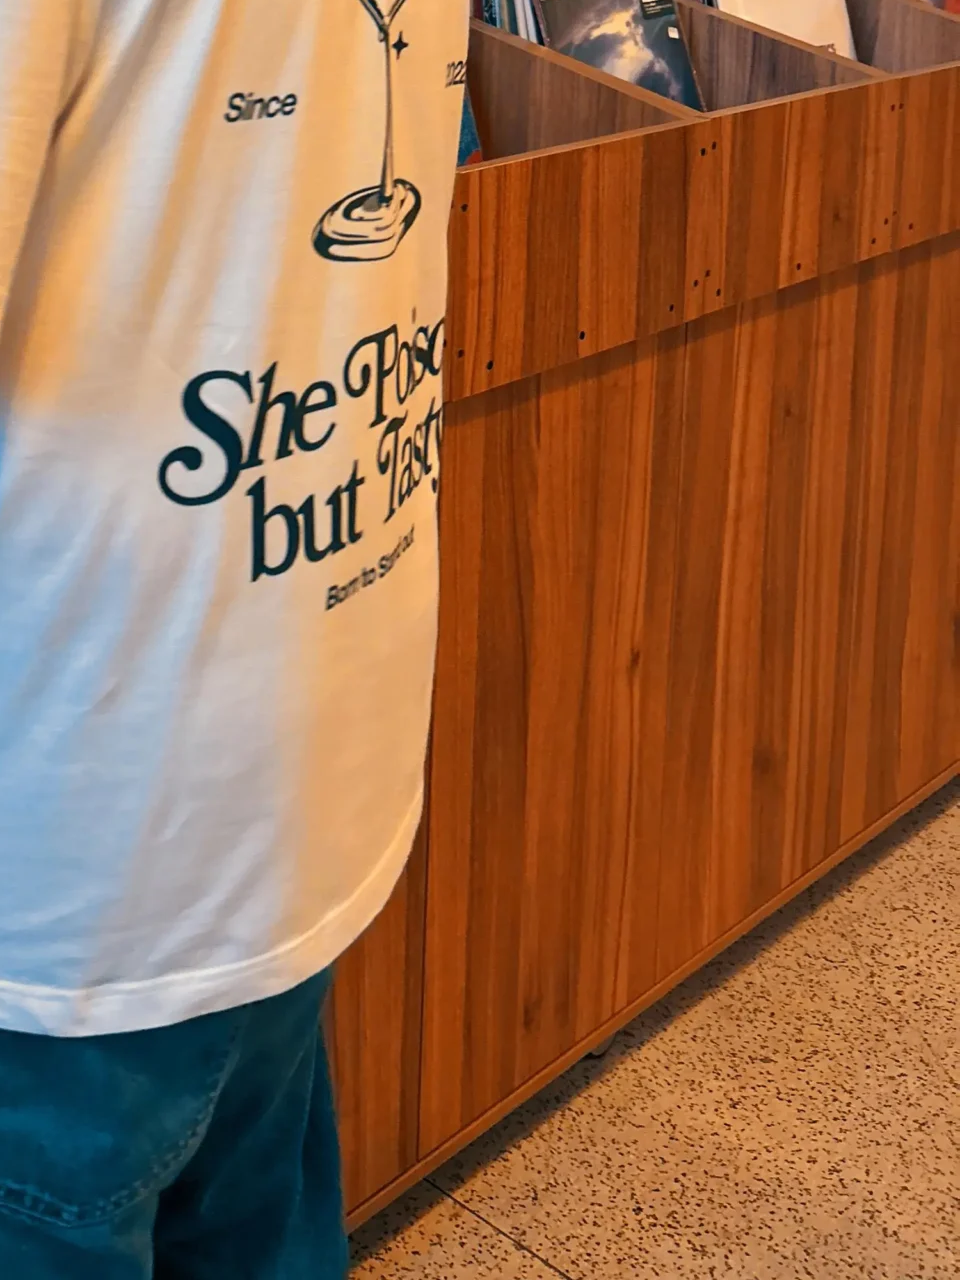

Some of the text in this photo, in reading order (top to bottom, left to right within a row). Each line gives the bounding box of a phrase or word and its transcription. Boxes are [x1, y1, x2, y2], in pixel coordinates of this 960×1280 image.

[224, 91, 297, 123] Since
[157, 306, 446, 506] She Poiso
[245, 460, 366, 583] but
[326, 576, 360, 611] Born
[362, 567, 377, 588] to
